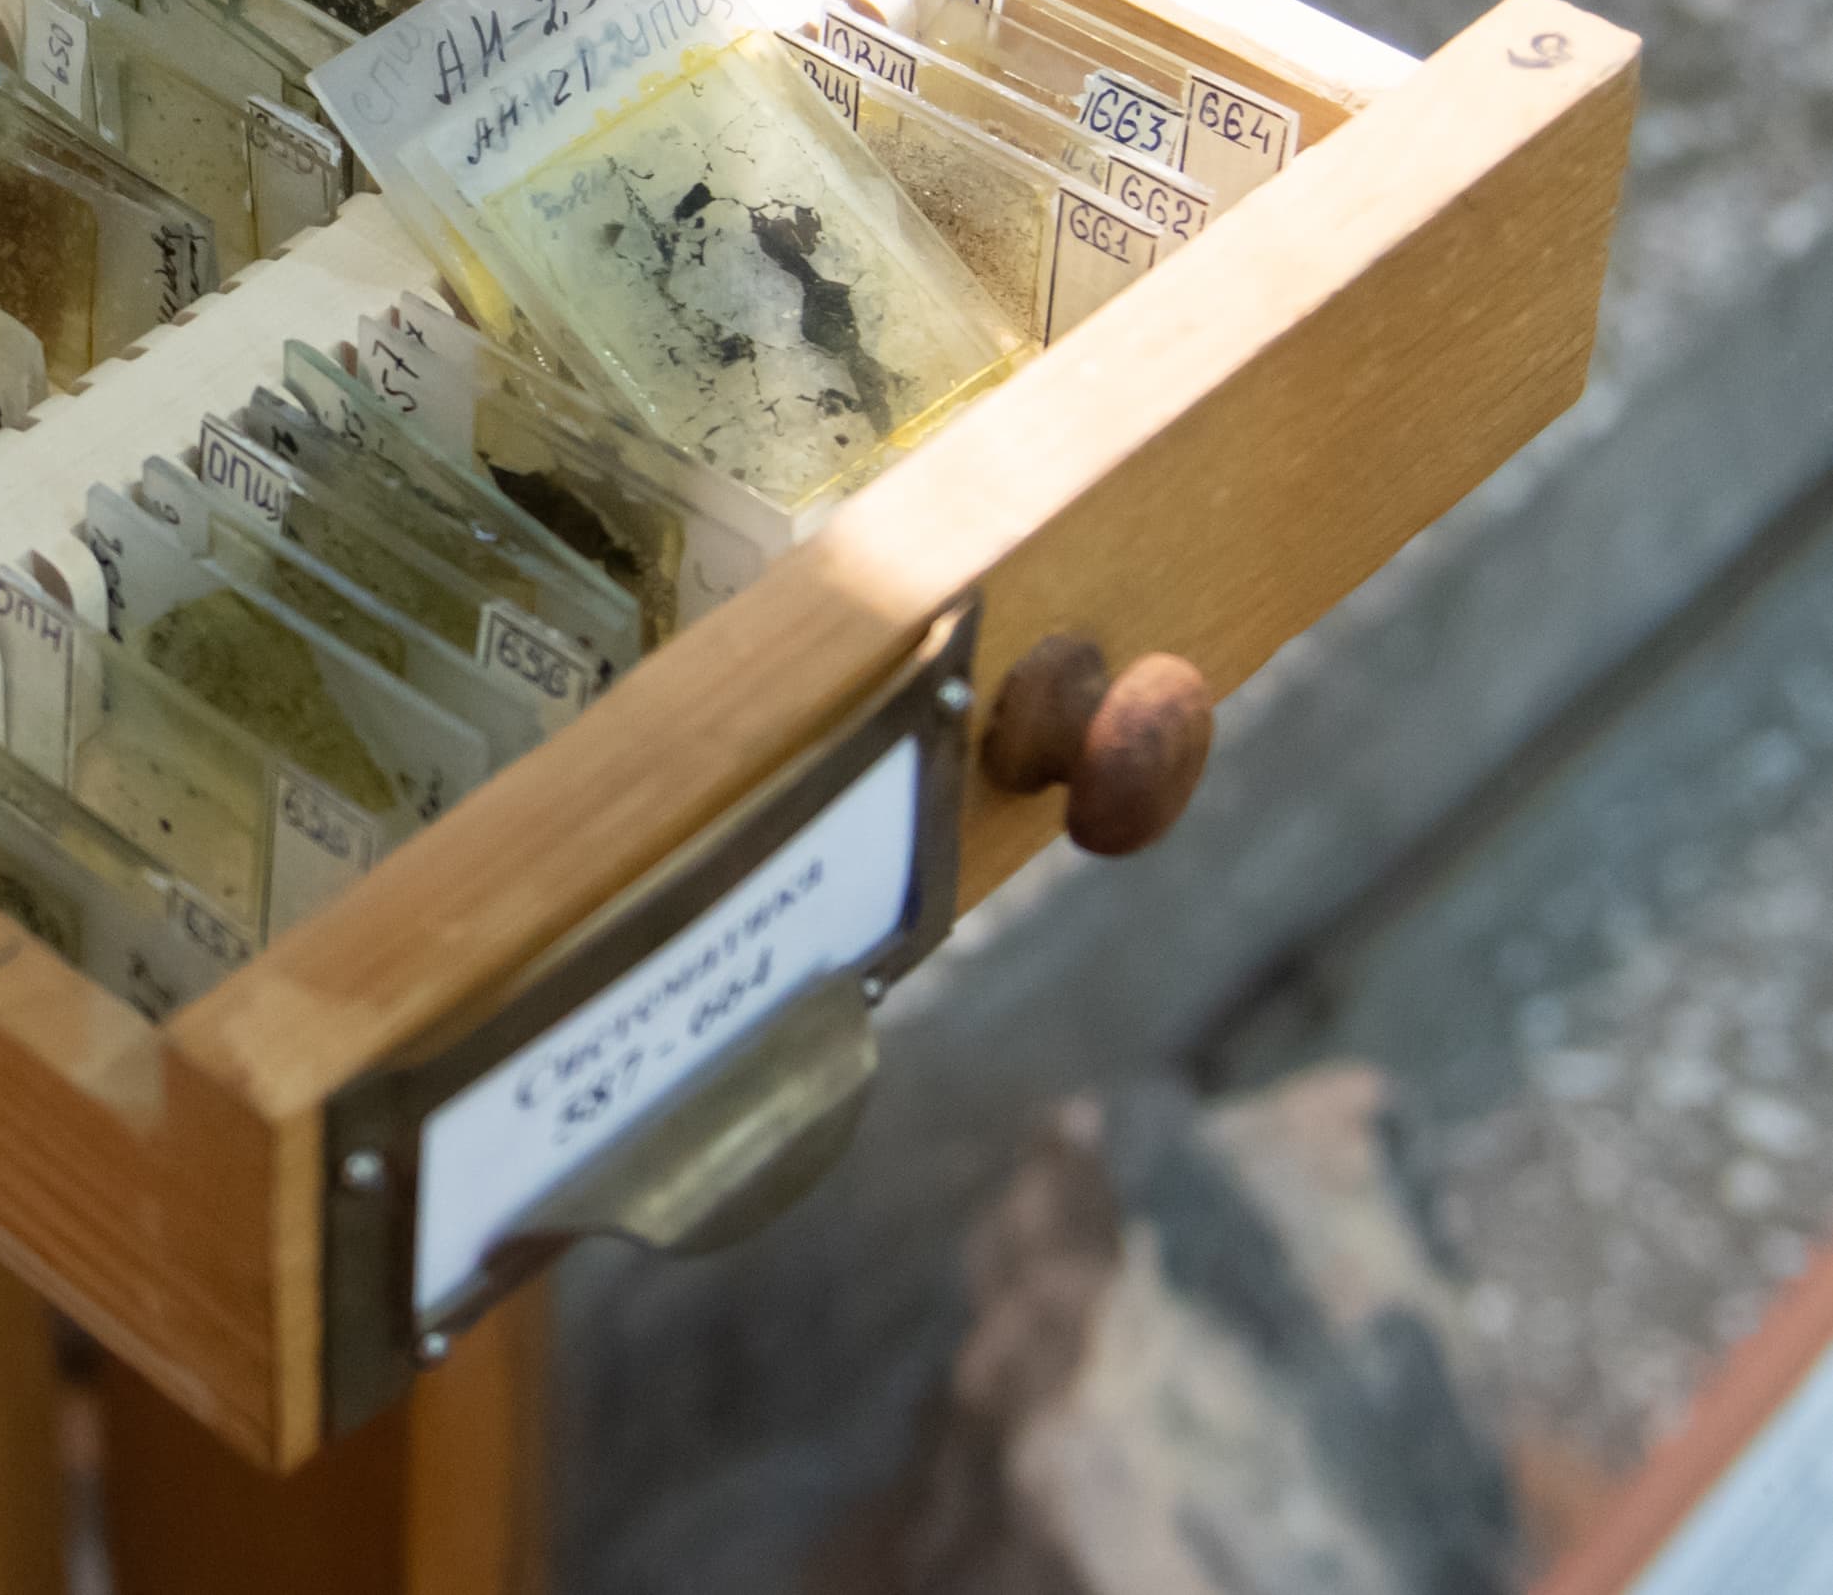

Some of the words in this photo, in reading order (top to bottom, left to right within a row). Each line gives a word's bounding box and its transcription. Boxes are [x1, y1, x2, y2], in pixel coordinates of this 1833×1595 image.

[1089, 88, 1167, 152] 663
[1199, 92, 1270, 154] 664
[1069, 202, 1129, 257] 661
[1120, 173, 1192, 240] 662
